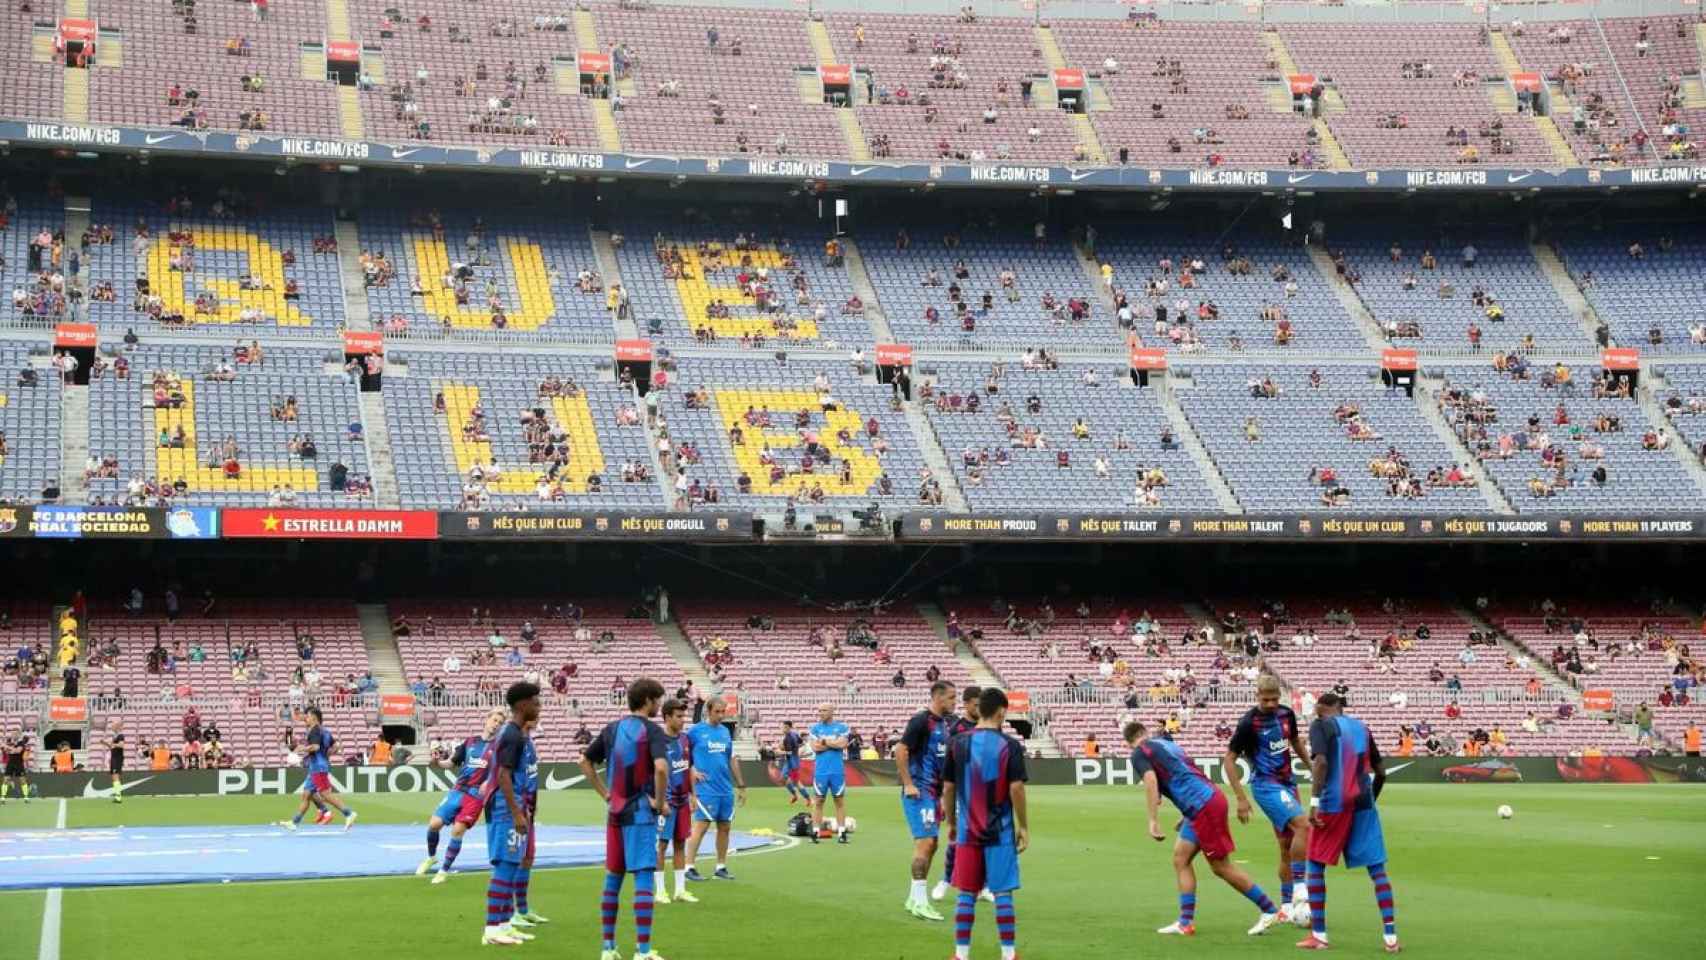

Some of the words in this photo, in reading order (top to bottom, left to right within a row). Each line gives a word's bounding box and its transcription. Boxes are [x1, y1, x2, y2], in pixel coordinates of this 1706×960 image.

[27, 124, 120, 144] NIKE.COM/FCB
[282, 138, 369, 158] NIKE.COM/FCB
[520, 150, 604, 168] NIKE.COM/FCB
[748, 161, 829, 176] NIKE.COM/FCB
[970, 167, 1050, 182] NIKE.COM/FCB
[32, 511, 52, 522] FC
[55, 511, 147, 522] BARCELONA
[29, 522, 70, 532] REAL
[73, 522, 151, 533] SOCIEDAD
[284, 519, 354, 532] ESTRELLA
[357, 519, 402, 533] DAMM
[515, 519, 537, 532] QUE
[539, 519, 554, 529] UN
[557, 519, 583, 529] CLUB
[643, 519, 665, 532] QUE
[666, 519, 705, 530] ORGULL
[944, 519, 972, 530] MORE
[975, 519, 1001, 530] THAN
[1003, 519, 1037, 530] PROUD
[1102, 520, 1121, 533] QUE
[1123, 520, 1157, 531] TALENT
[1193, 521, 1220, 532] MORE
[1222, 521, 1248, 531] THAN
[1250, 521, 1284, 532] TALENT
[1343, 521, 1363, 534] QUE
[1365, 521, 1379, 531] UN
[1381, 521, 1405, 532] CLUB
[1466, 521, 1485, 534] QUE
[1487, 521, 1495, 532] 11
[1497, 521, 1548, 532] JUGADORS
[1584, 521, 1610, 532] MORE
[1613, 521, 1639, 532] THAN
[1641, 521, 1648, 532] 11
[1651, 521, 1693, 532] PLAYERS
[920, 808, 935, 823] 14
